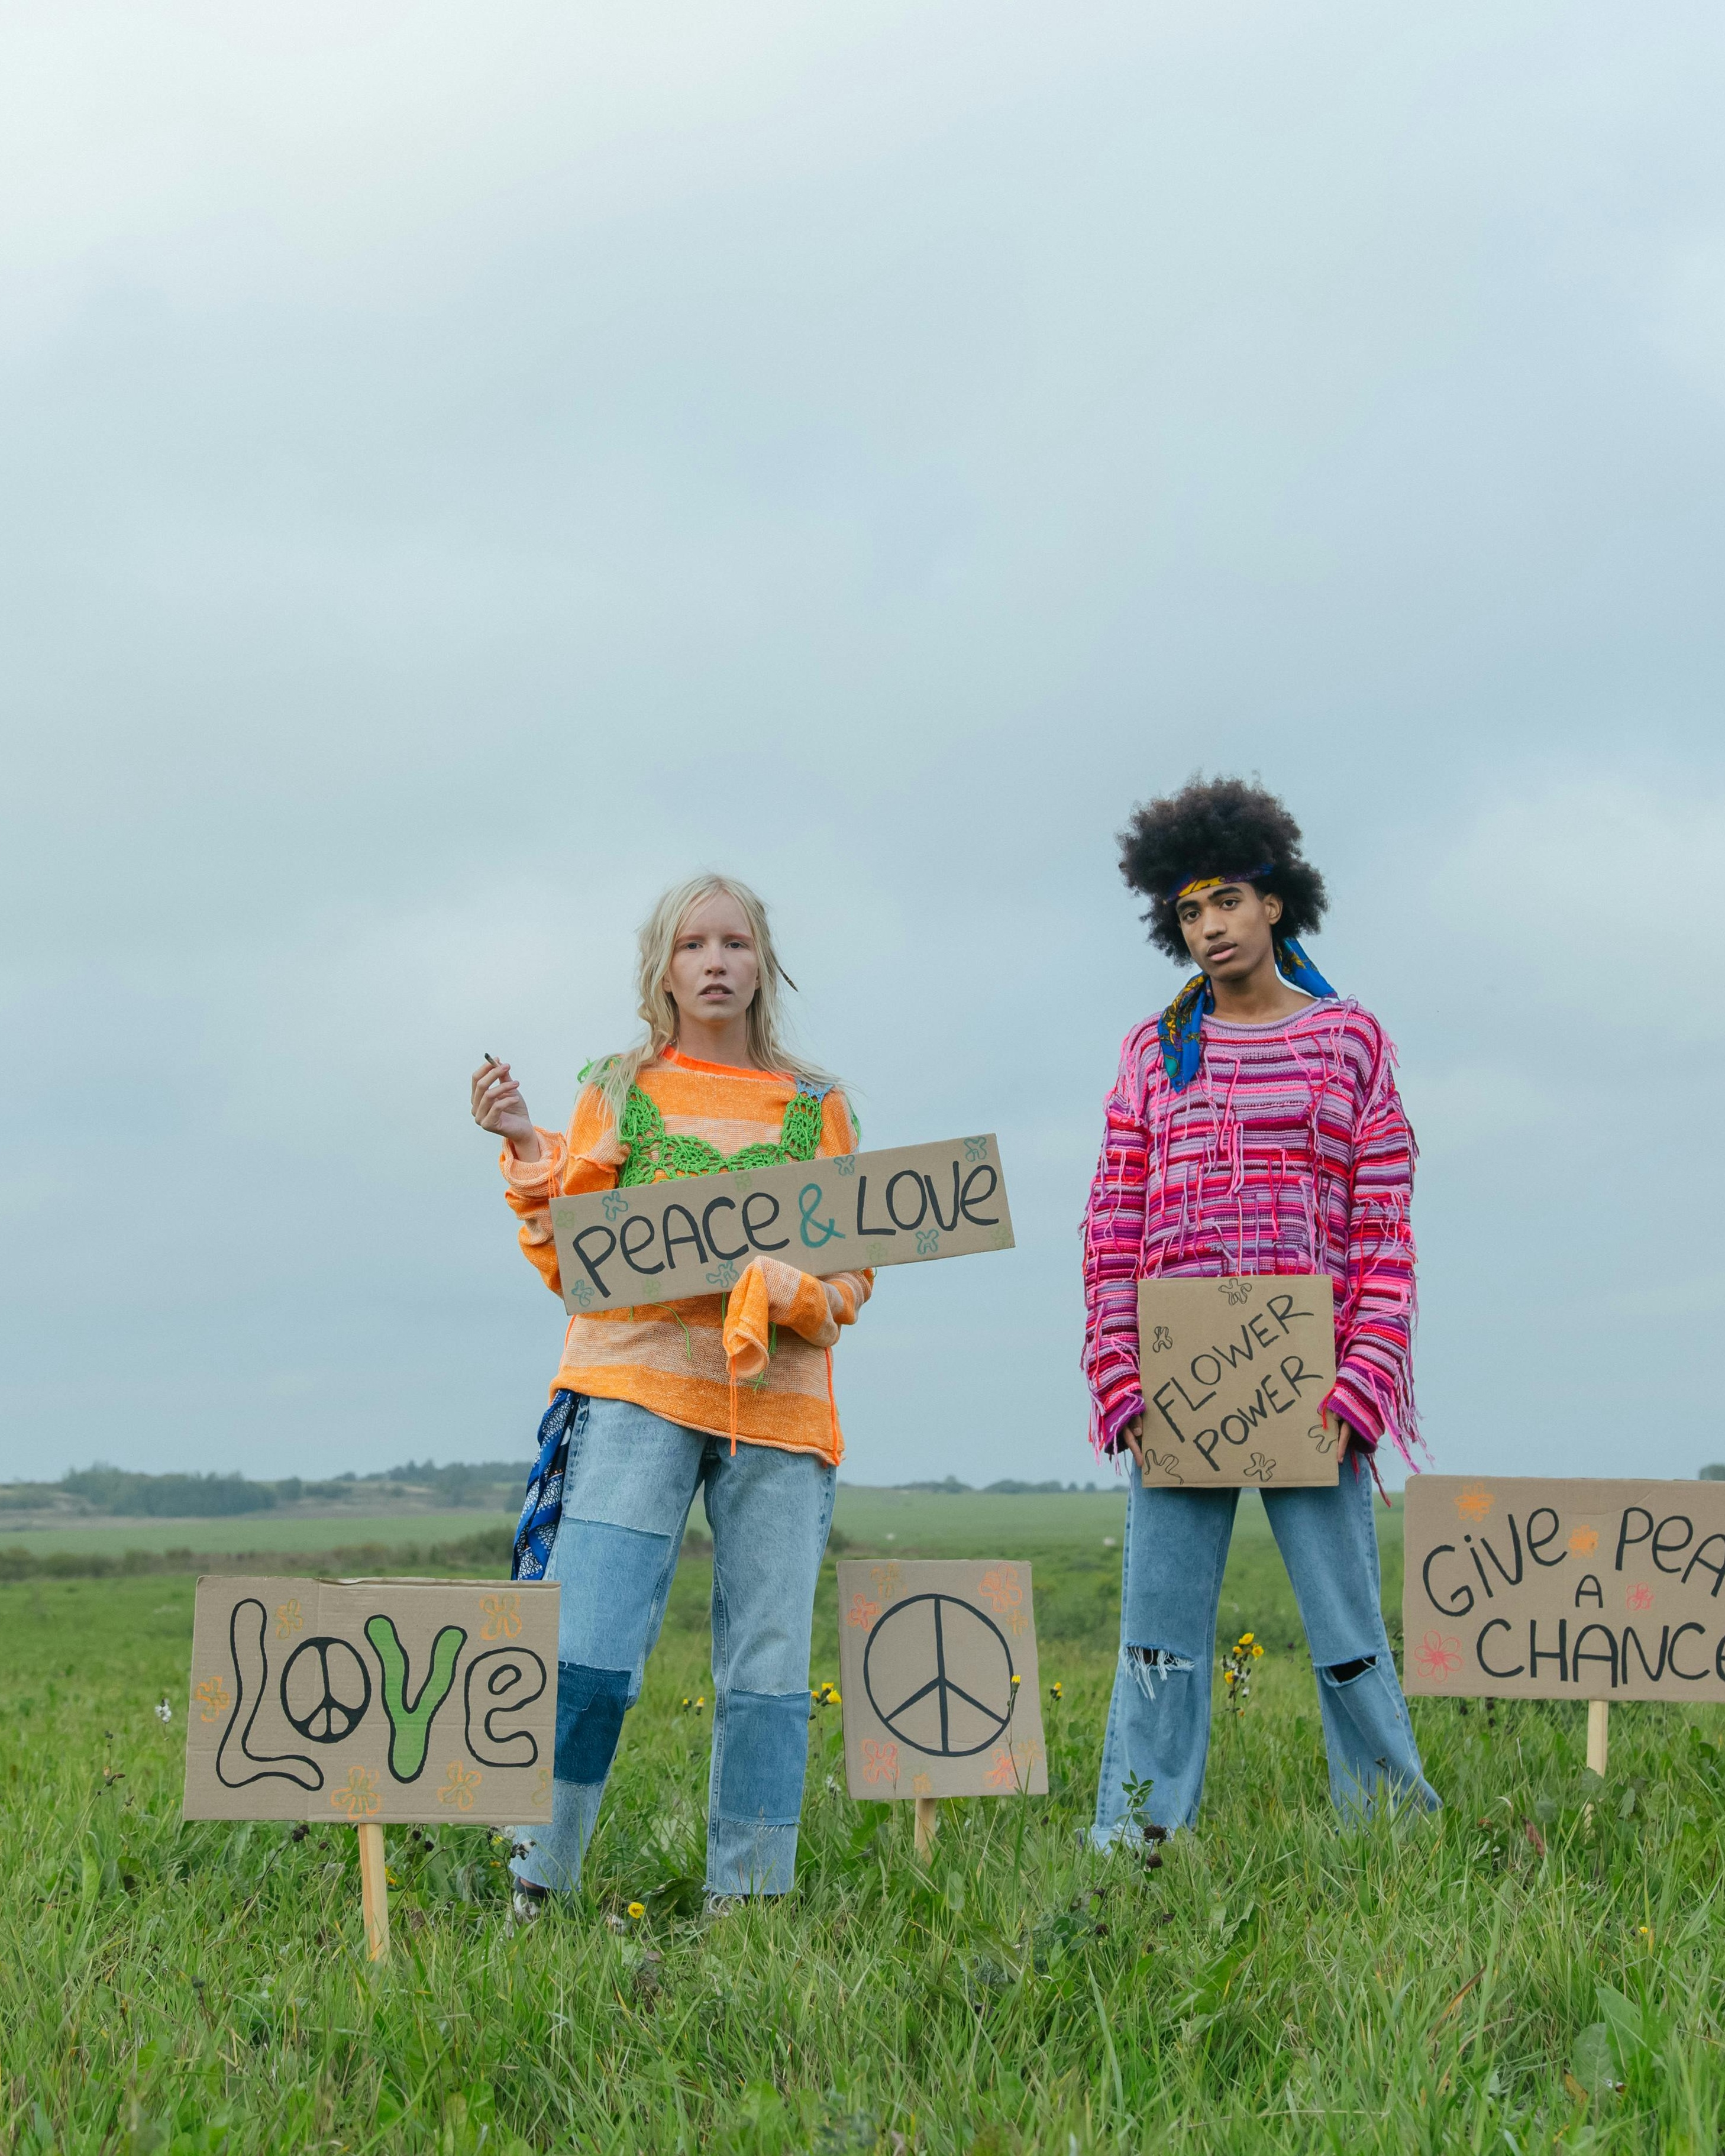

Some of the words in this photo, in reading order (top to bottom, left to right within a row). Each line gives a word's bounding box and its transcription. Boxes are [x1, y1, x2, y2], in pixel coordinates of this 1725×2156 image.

[799, 1183, 847, 1249] &
[1152, 1294, 1314, 1443] FLOWER
[1193, 1356, 1324, 1472] POWER
[1575, 1574, 1604, 1608] A
[1476, 1618, 1725, 1688] CHANC
